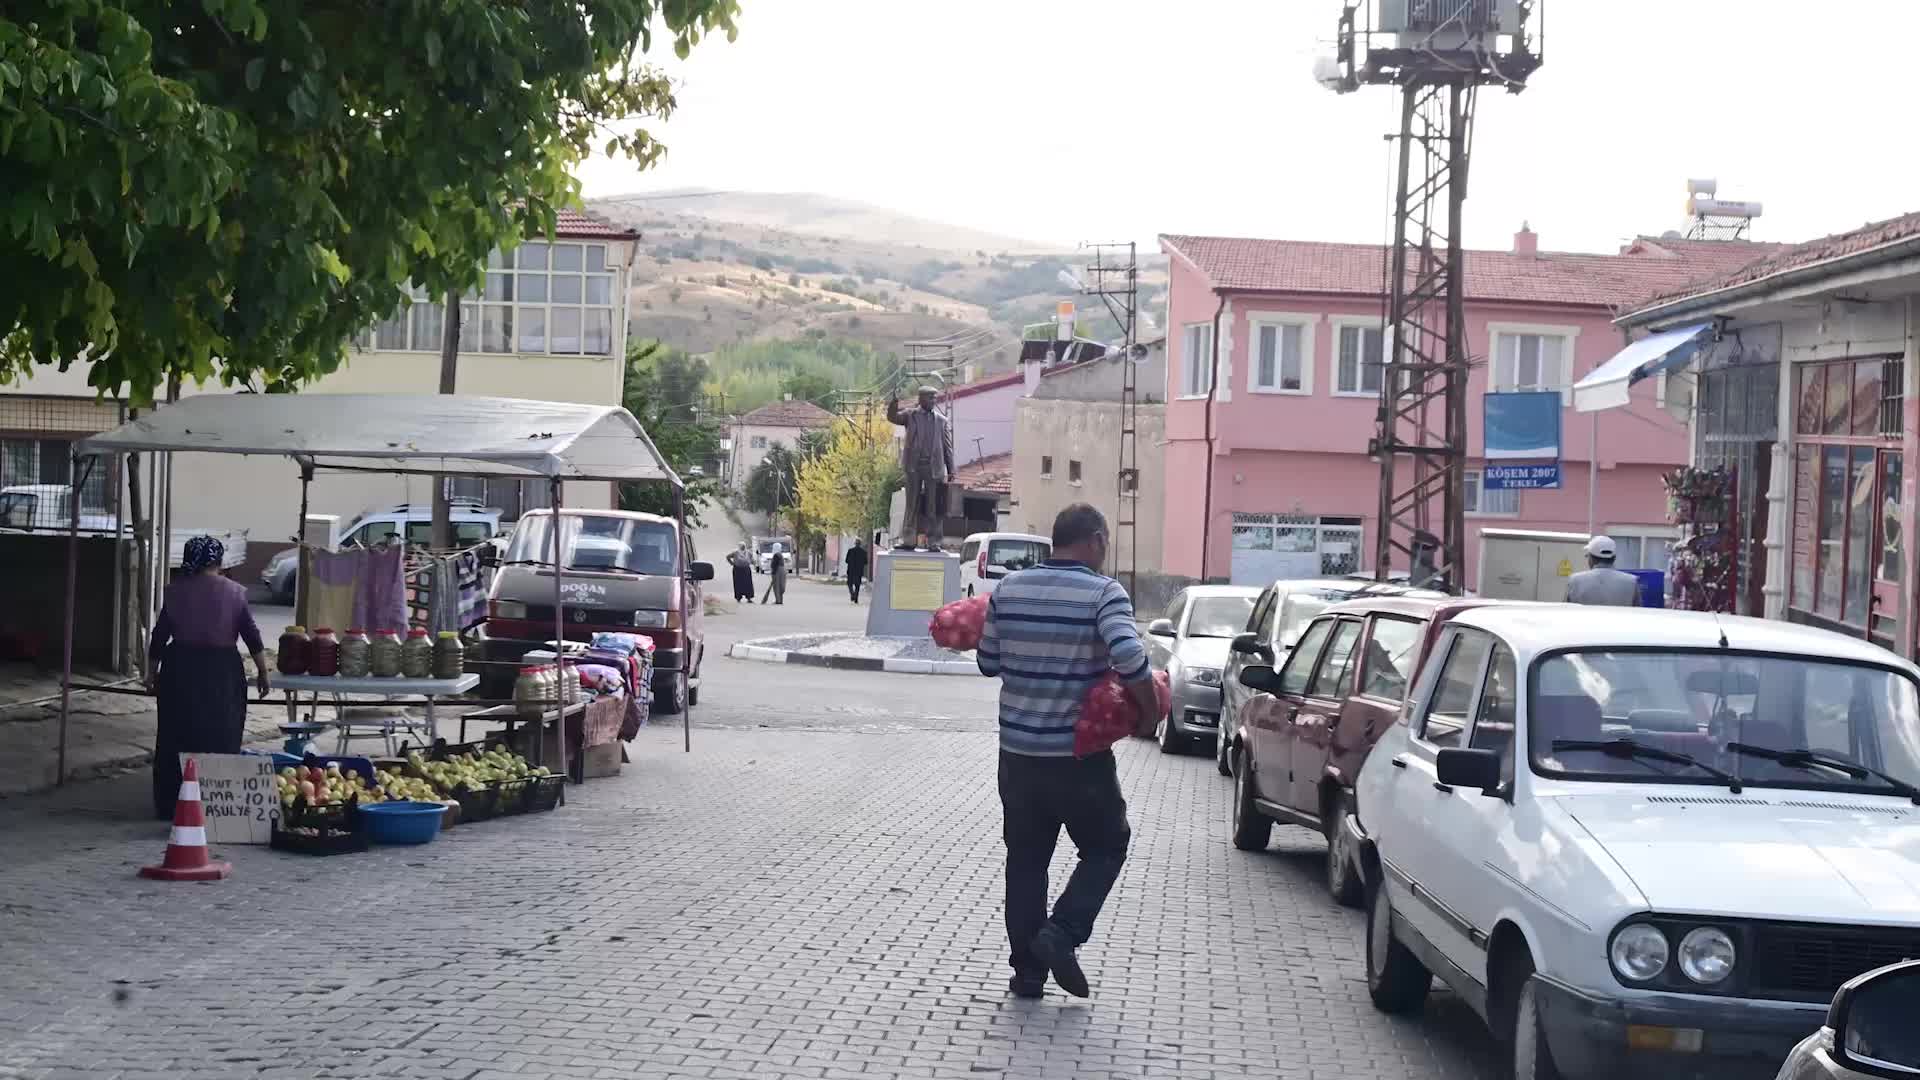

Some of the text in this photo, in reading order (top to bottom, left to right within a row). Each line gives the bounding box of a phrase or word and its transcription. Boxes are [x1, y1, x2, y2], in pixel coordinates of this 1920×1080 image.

[1531, 467, 1556, 478] 2007
[1503, 479, 1540, 488] TEKEL
[201, 791, 234, 802] LMA
[205, 805, 251, 818] ASULYE
